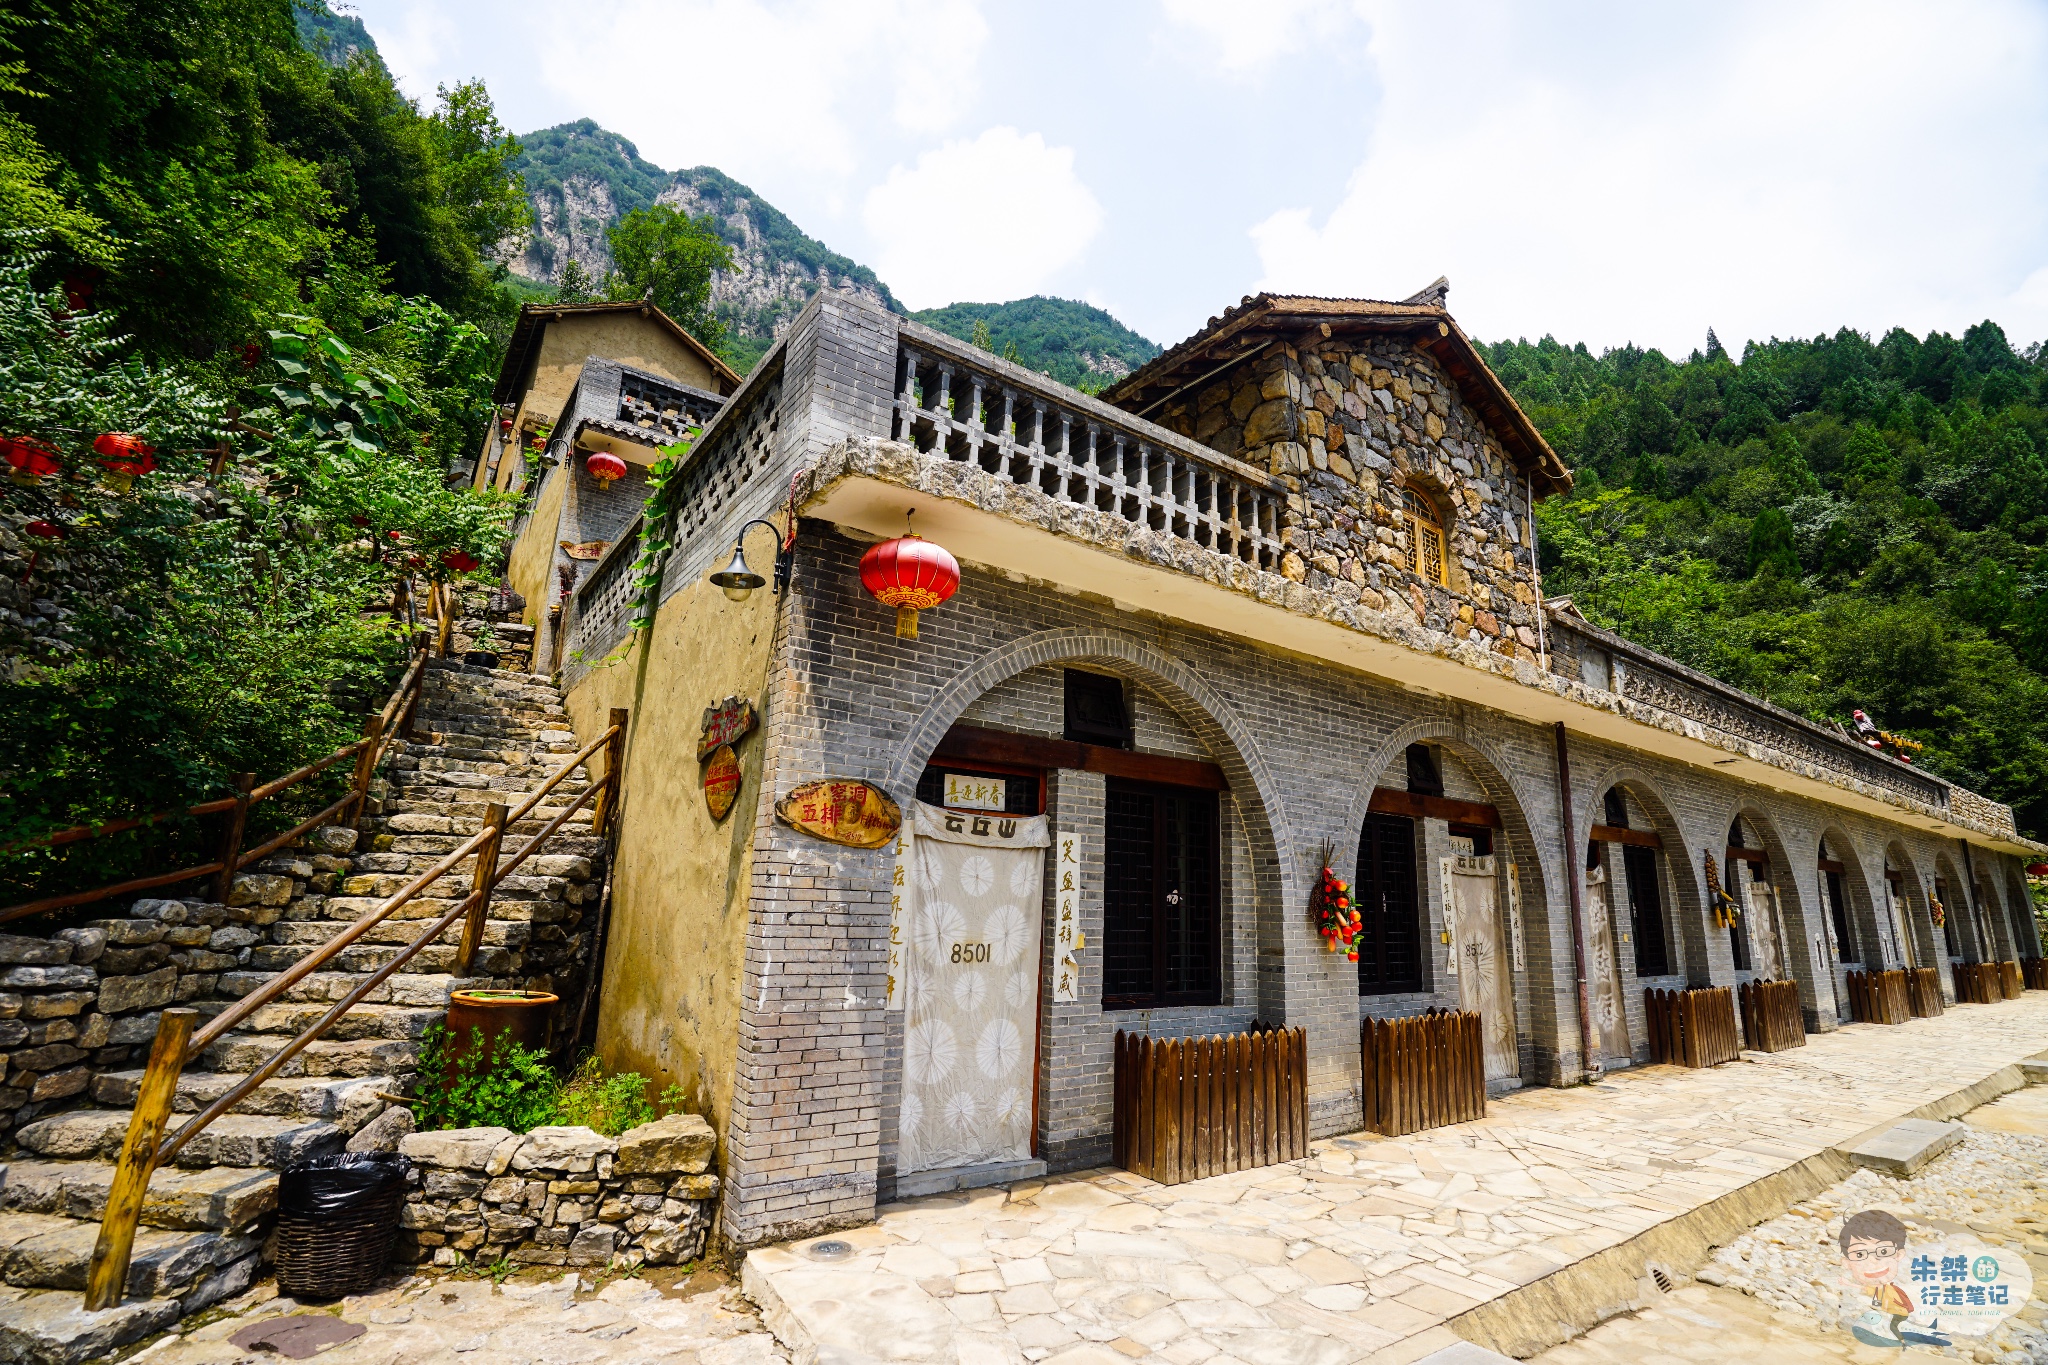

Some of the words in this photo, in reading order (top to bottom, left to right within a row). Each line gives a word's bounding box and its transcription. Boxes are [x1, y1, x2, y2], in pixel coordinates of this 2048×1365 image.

[945, 778, 1005, 807] 喜迎新春
[801, 803, 842, 827] 五排
[945, 811, 1017, 839] 云丘山
[951, 943, 991, 964] 8501
